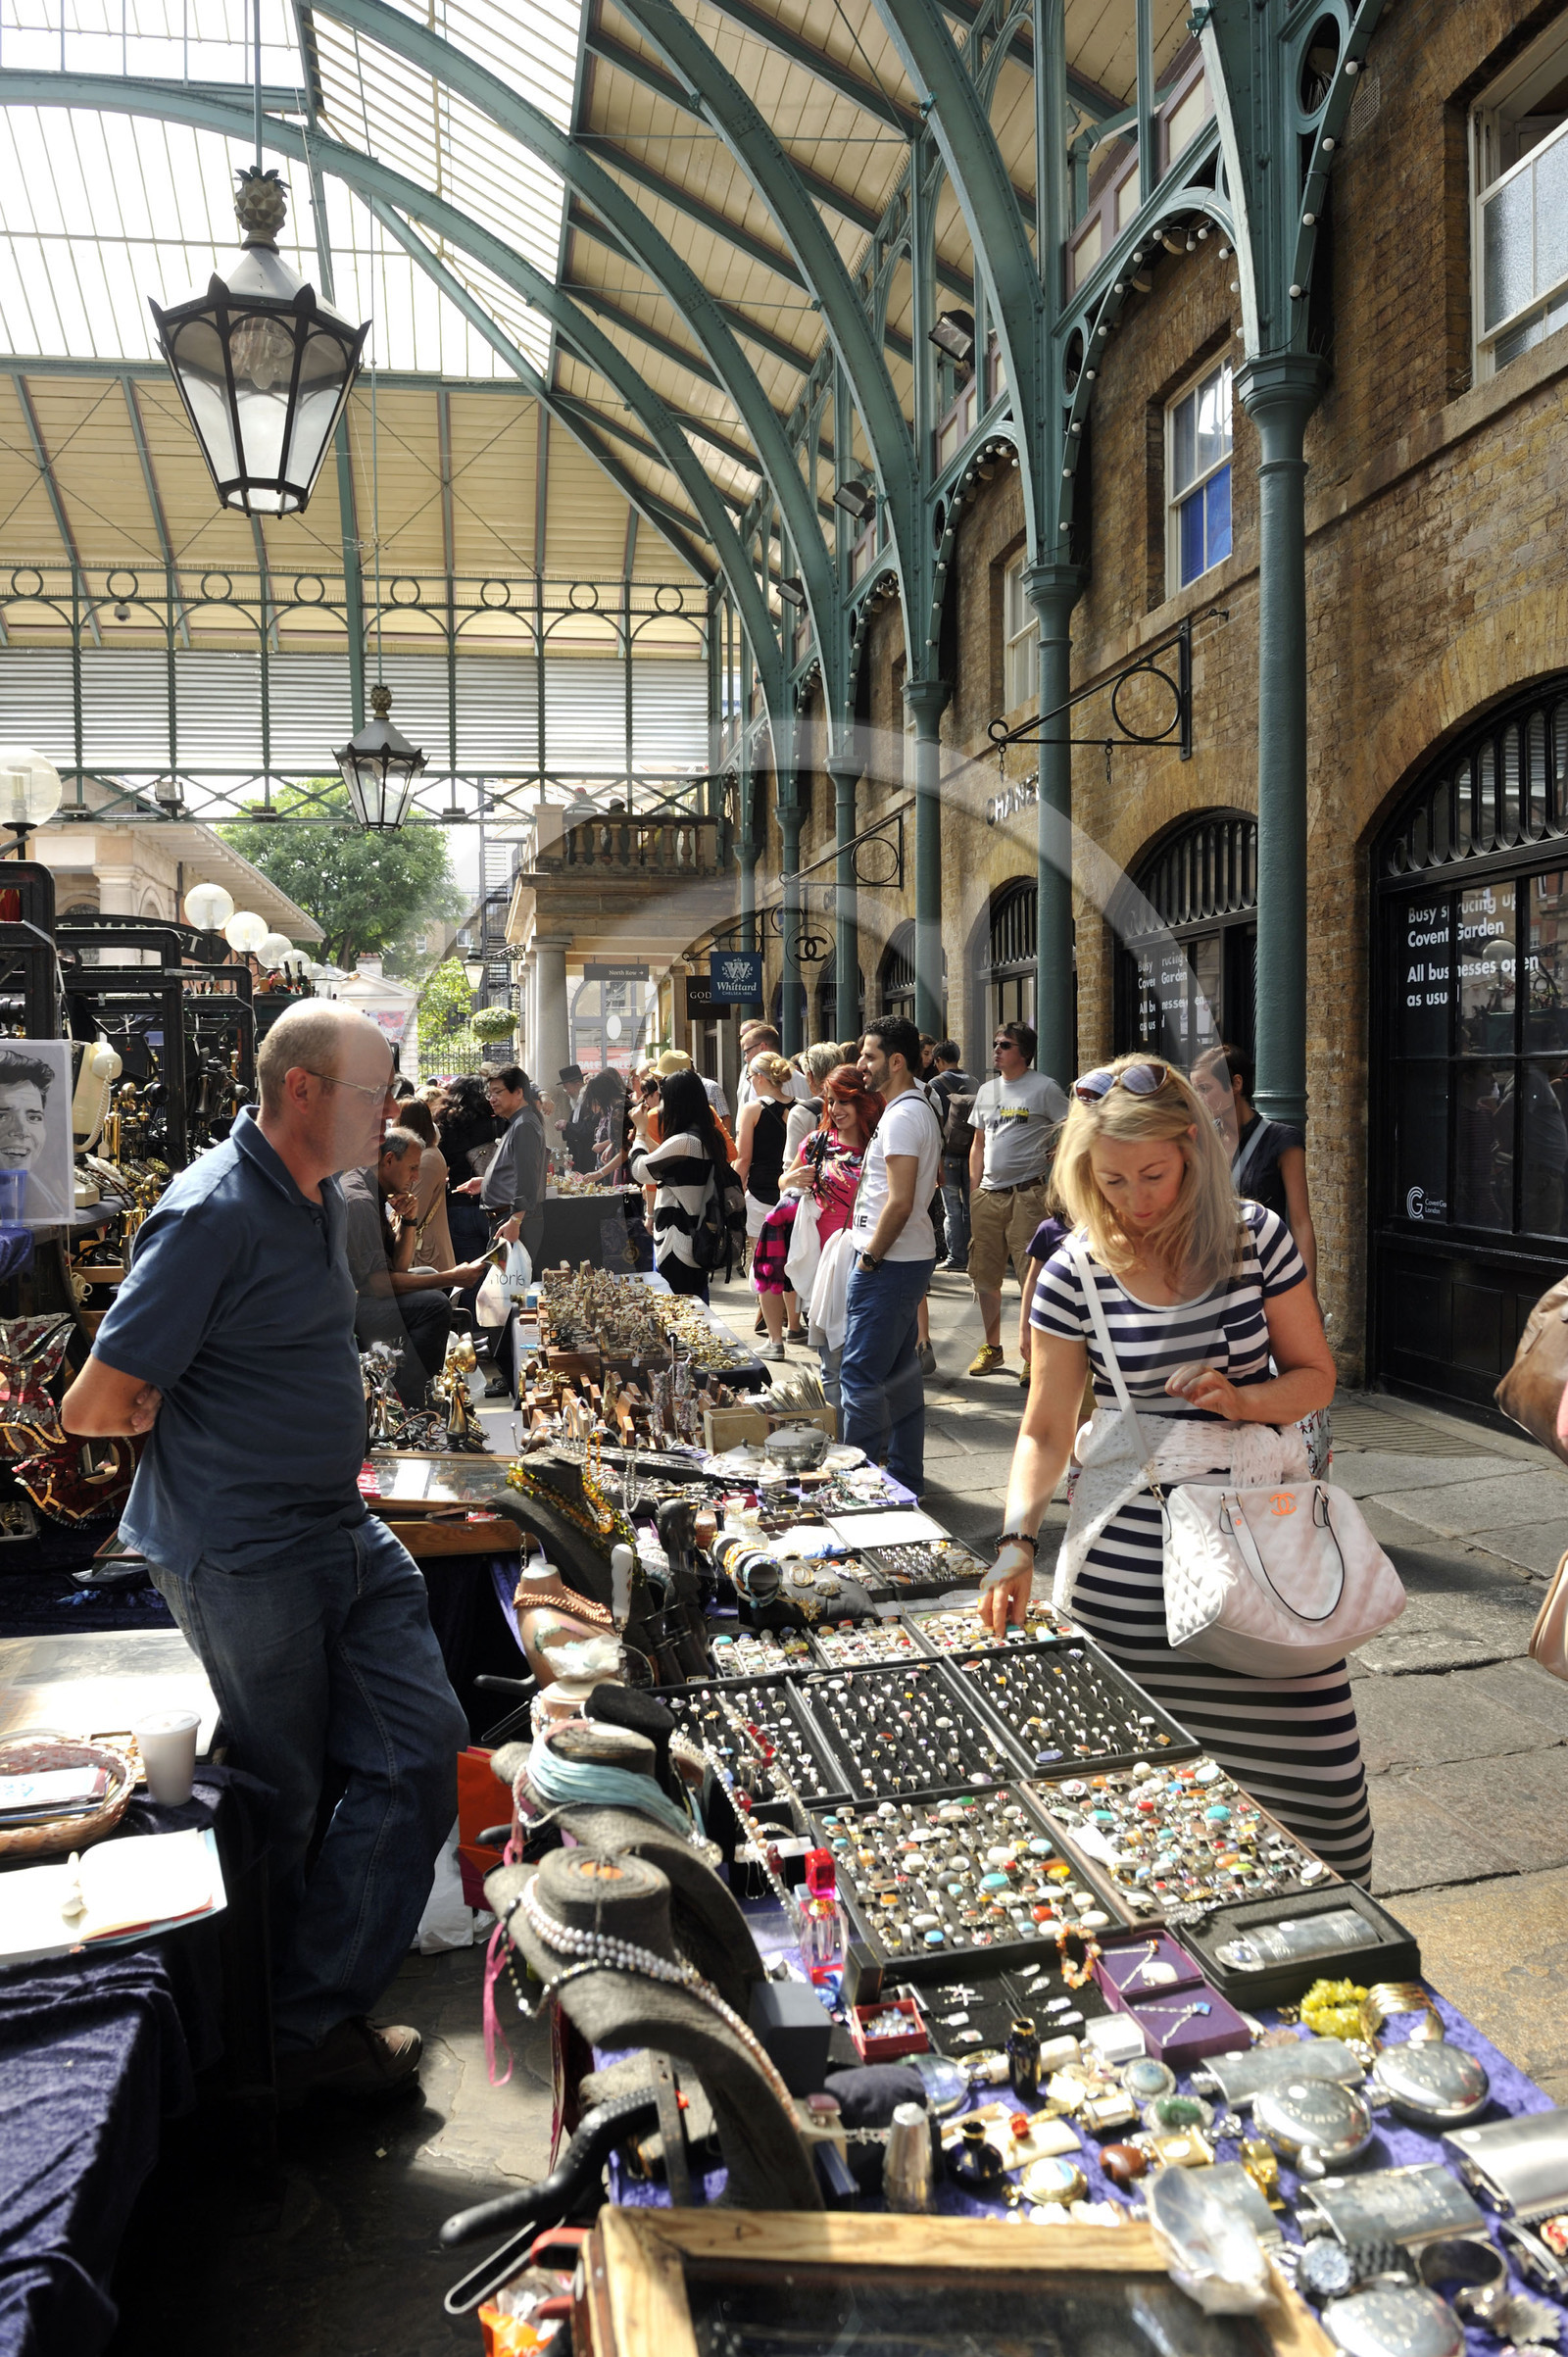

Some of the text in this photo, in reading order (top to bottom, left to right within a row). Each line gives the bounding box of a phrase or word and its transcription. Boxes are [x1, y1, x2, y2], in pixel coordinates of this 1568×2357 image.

[1408, 908, 1437, 925] Busy
[1407, 927, 1449, 948] Covent
[1138, 959, 1152, 973] Busy
[1406, 963, 1424, 982] All
[1428, 960, 1496, 981] busnesses
[1161, 968, 1188, 984] Garden
[716, 981, 757, 991] Whittard
[689, 991, 712, 1000] GOD
[1406, 984, 1459, 1007] as usul
